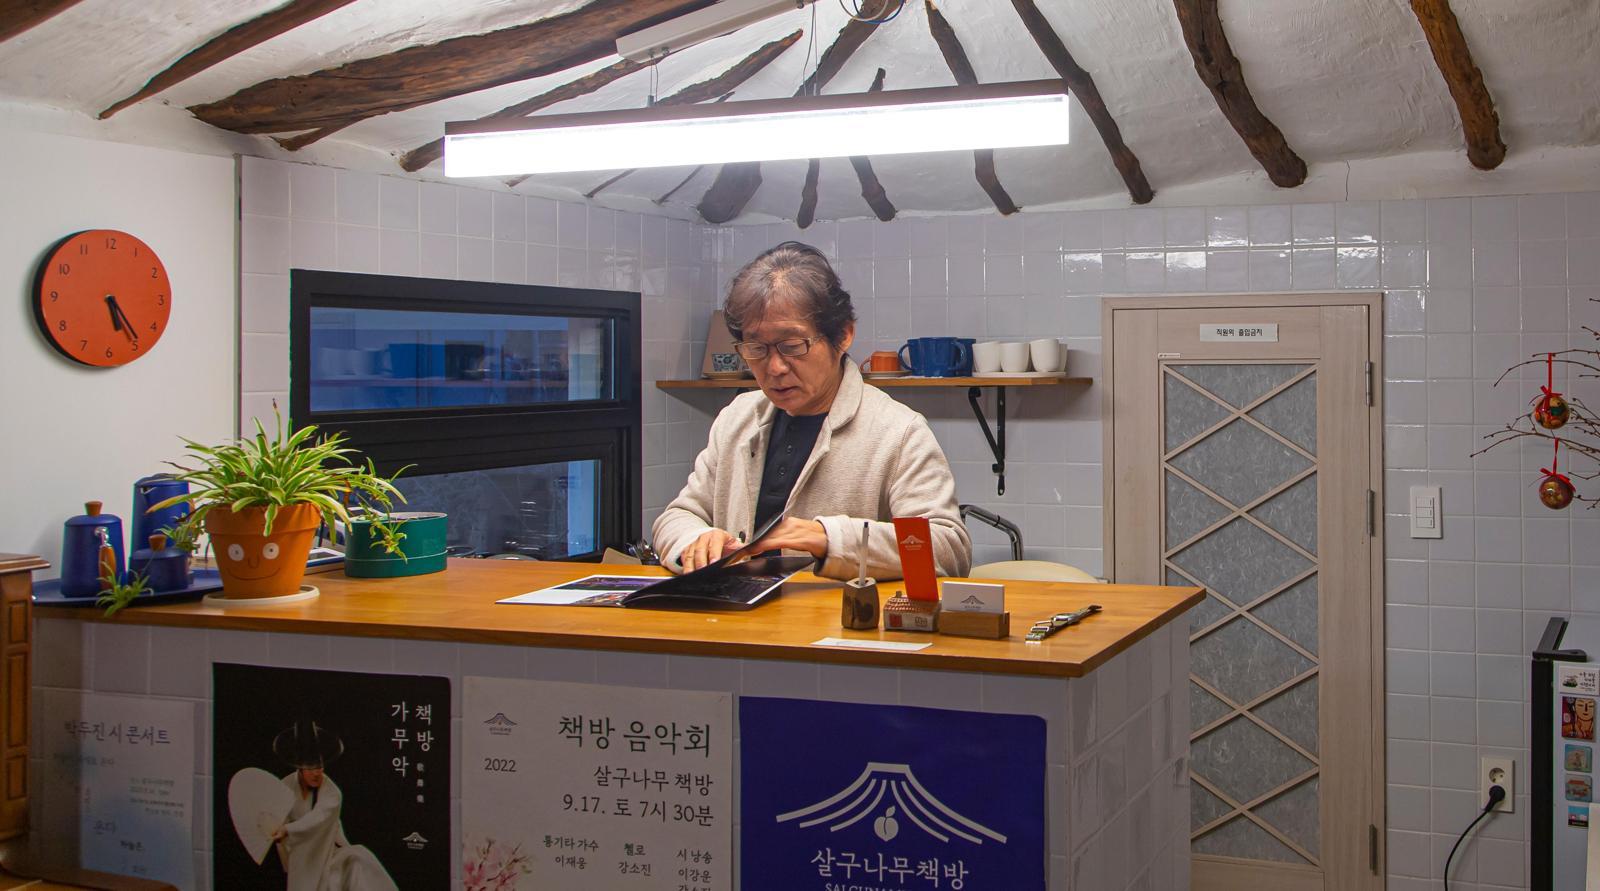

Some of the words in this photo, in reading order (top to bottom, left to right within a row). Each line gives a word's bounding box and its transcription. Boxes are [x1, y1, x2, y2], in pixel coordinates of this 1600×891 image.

[79, 244, 88, 256] 11
[105, 238, 117, 250] 12
[133, 247, 138, 257] 1
[58, 263, 70, 275] 10
[151, 267, 158, 279] 2
[50, 291, 58, 303] 9
[158, 294, 164, 306] 3
[59, 320, 67, 332] 8
[150, 321, 157, 332] 4
[1238, 328, 1263, 337] 출입금지
[80, 340, 88, 351] 7
[132, 340, 138, 351] 5
[105, 347, 113, 358] 6
[109, 722, 122, 744] 시
[126, 726, 171, 746] 콘서트
[415, 704, 435, 752] 책방
[391, 701, 409, 778] 가무악
[558, 714, 616, 750] 책방
[623, 720, 711, 758] 음악회
[484, 757, 517, 773] 2022
[562, 793, 606, 815] 9.17.
[613, 798, 633, 817] 토
[639, 800, 667, 823] 7시
[673, 803, 714, 828] 30분
[577, 838, 600, 853] 가수
[618, 860, 651, 877] 강소진
[810, 847, 969, 891] 살구나무책방
